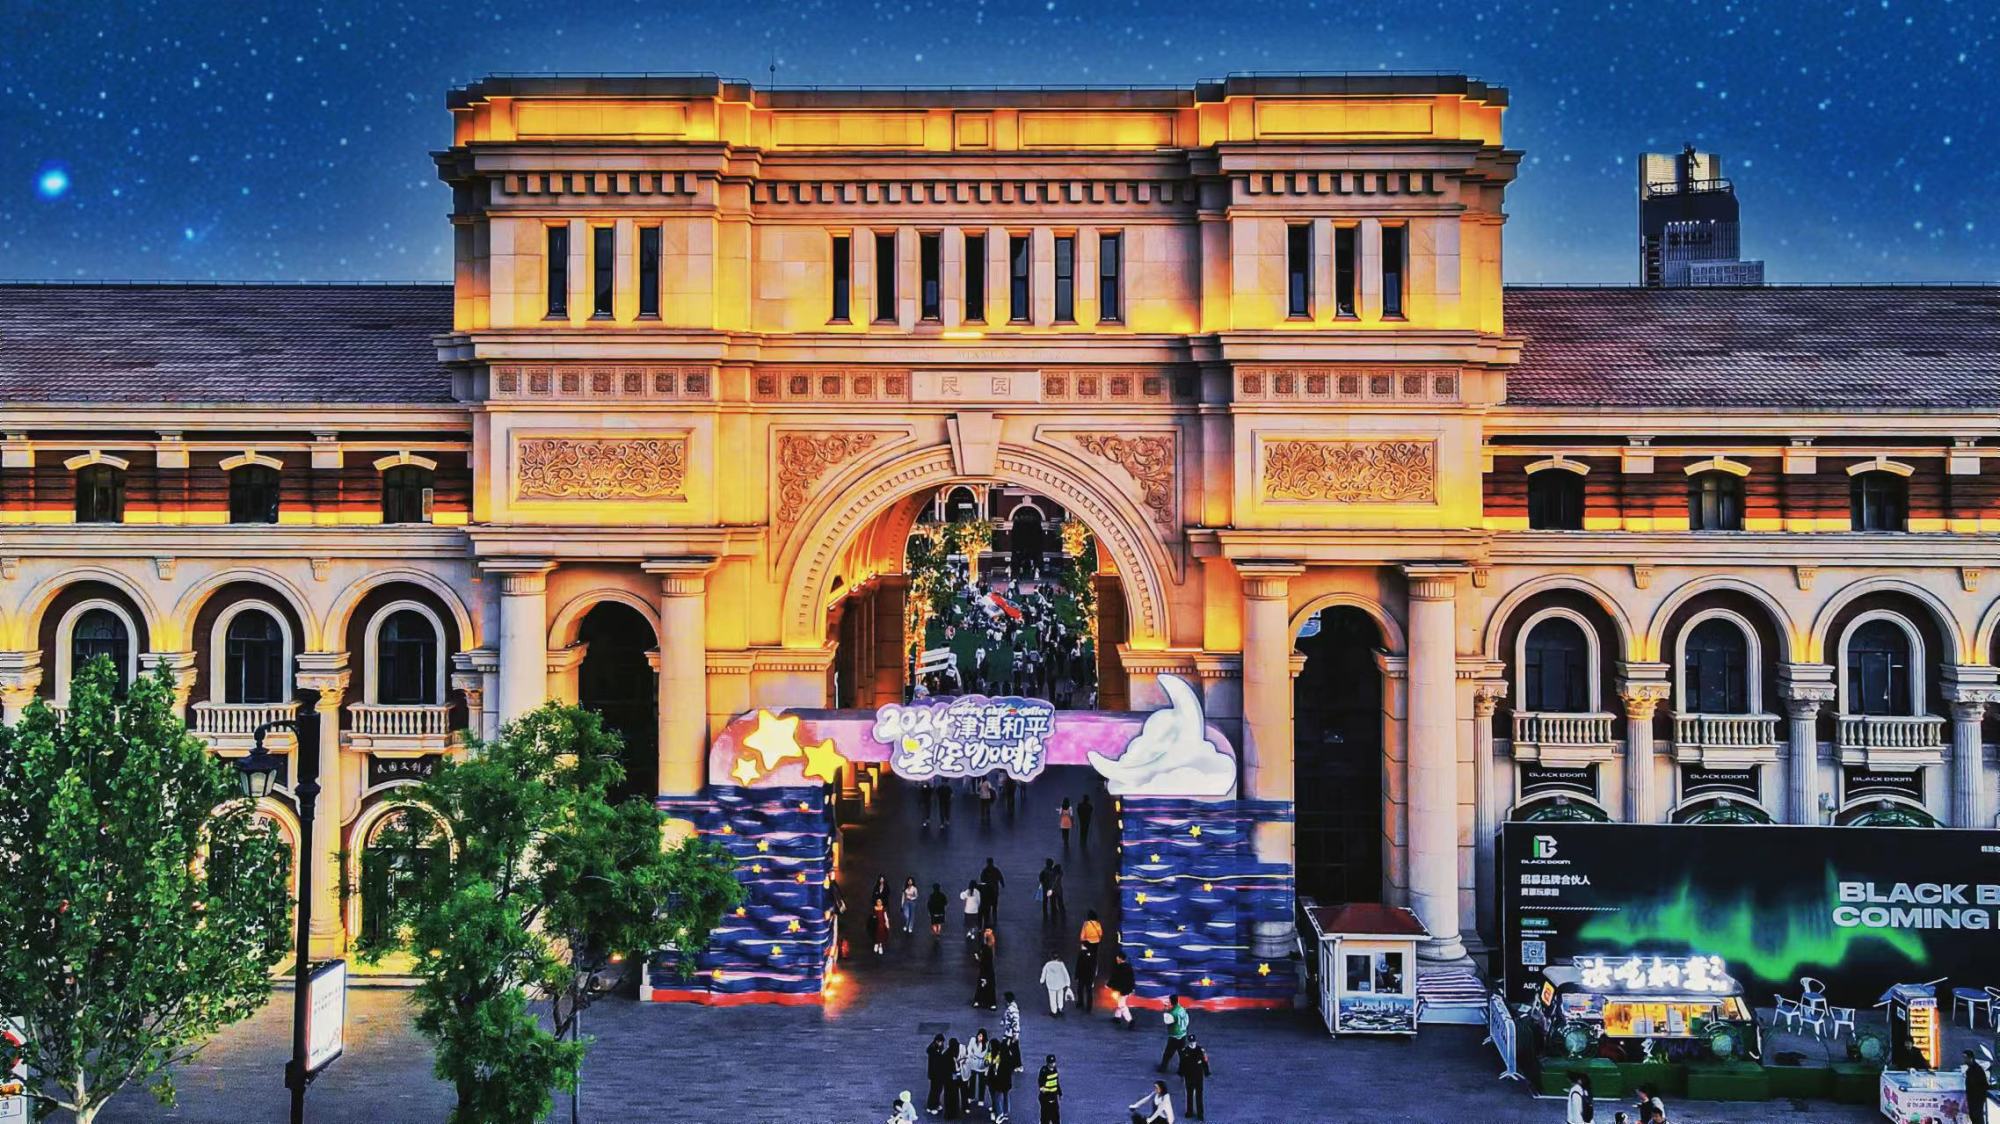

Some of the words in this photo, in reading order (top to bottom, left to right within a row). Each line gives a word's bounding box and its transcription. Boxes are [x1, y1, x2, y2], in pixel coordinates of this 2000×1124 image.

[879, 708, 953, 738] 2024
[954, 715, 1048, 740] 津遇和平
[901, 733, 1042, 775] 星空咖啡
[1520, 874, 1591, 886] 招募品牌合伙人
[1839, 881, 1969, 905] BLACK
[1832, 906, 1990, 930] COMING
